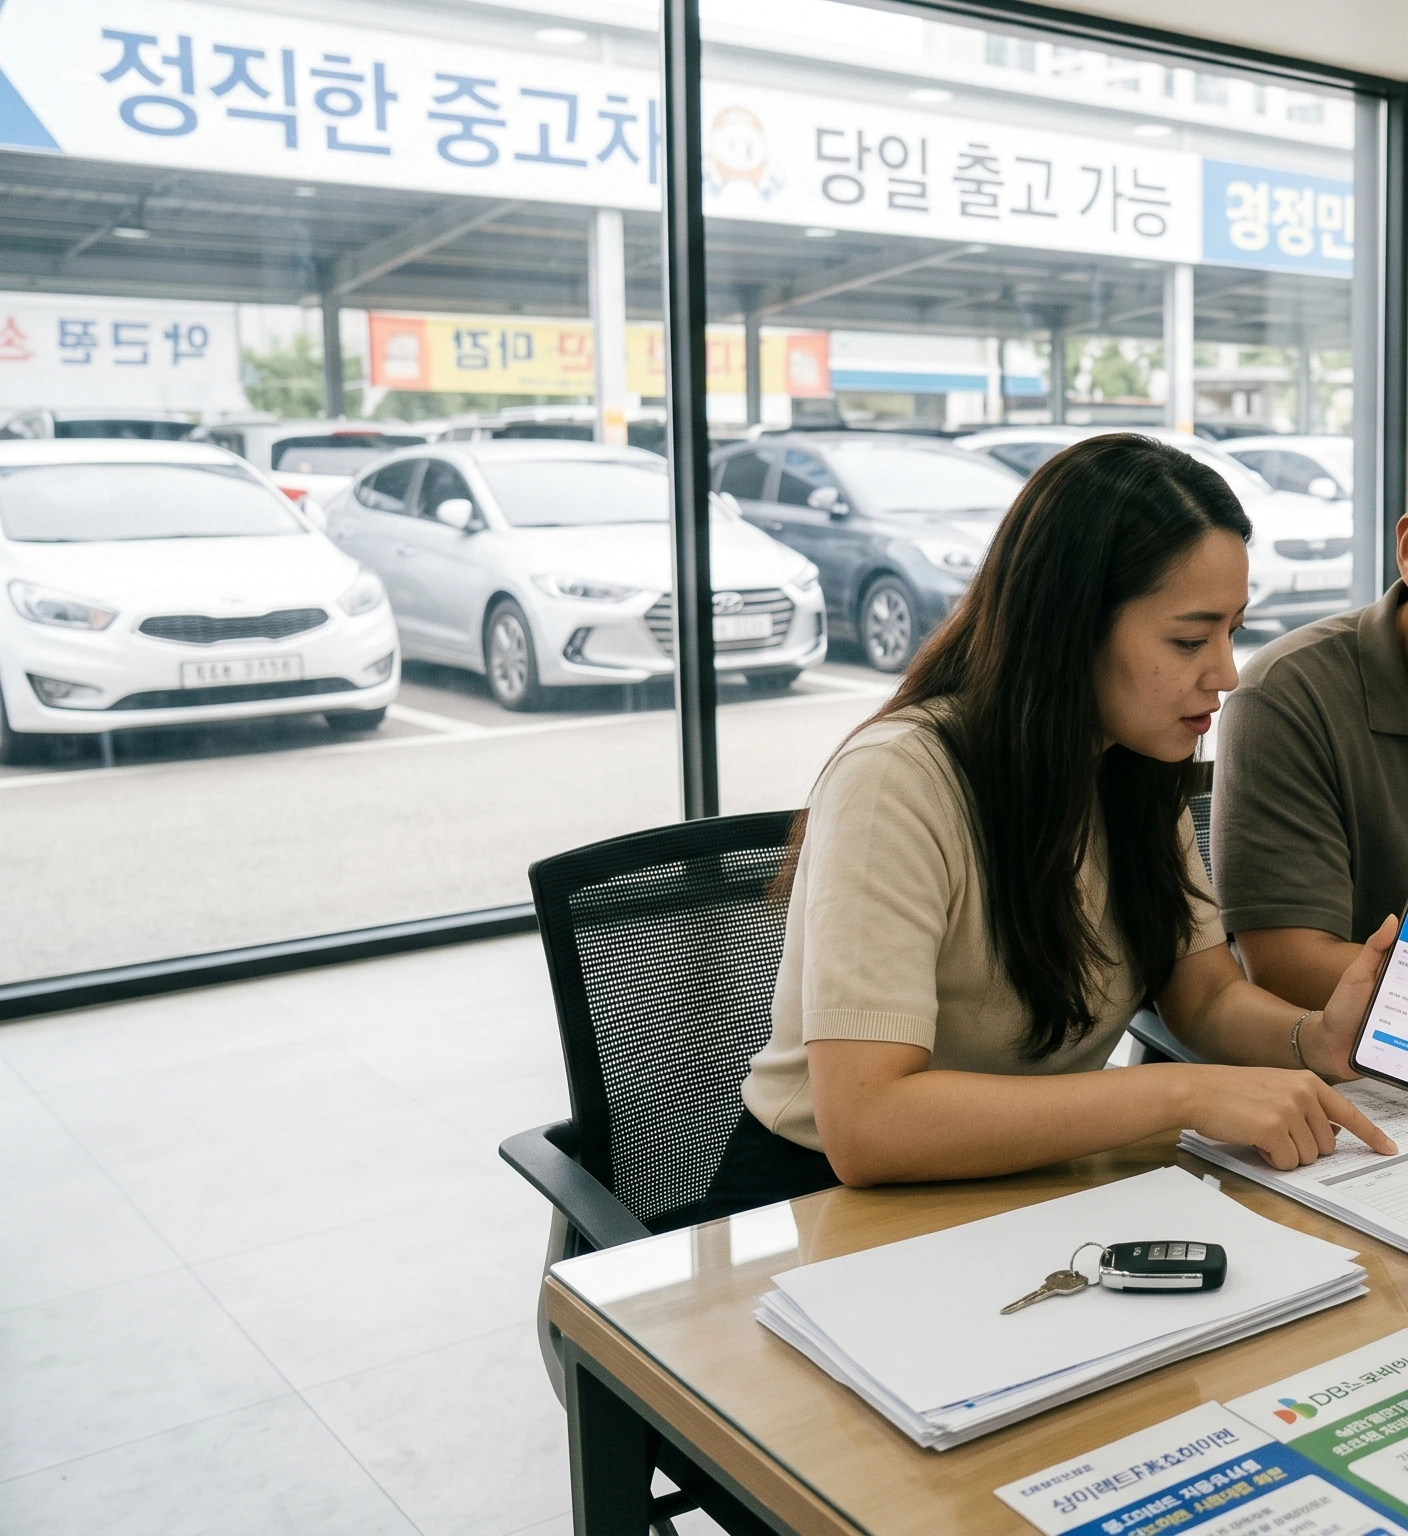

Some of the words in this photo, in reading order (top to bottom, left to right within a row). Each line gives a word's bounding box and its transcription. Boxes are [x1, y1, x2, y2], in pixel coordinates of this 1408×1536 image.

[101, 28, 398, 156] 정직한
[427, 73, 661, 185] 중고차
[815, 127, 931, 212] 당일
[953, 143, 1059, 220] 출고
[1080, 163, 1172, 239] 가능
